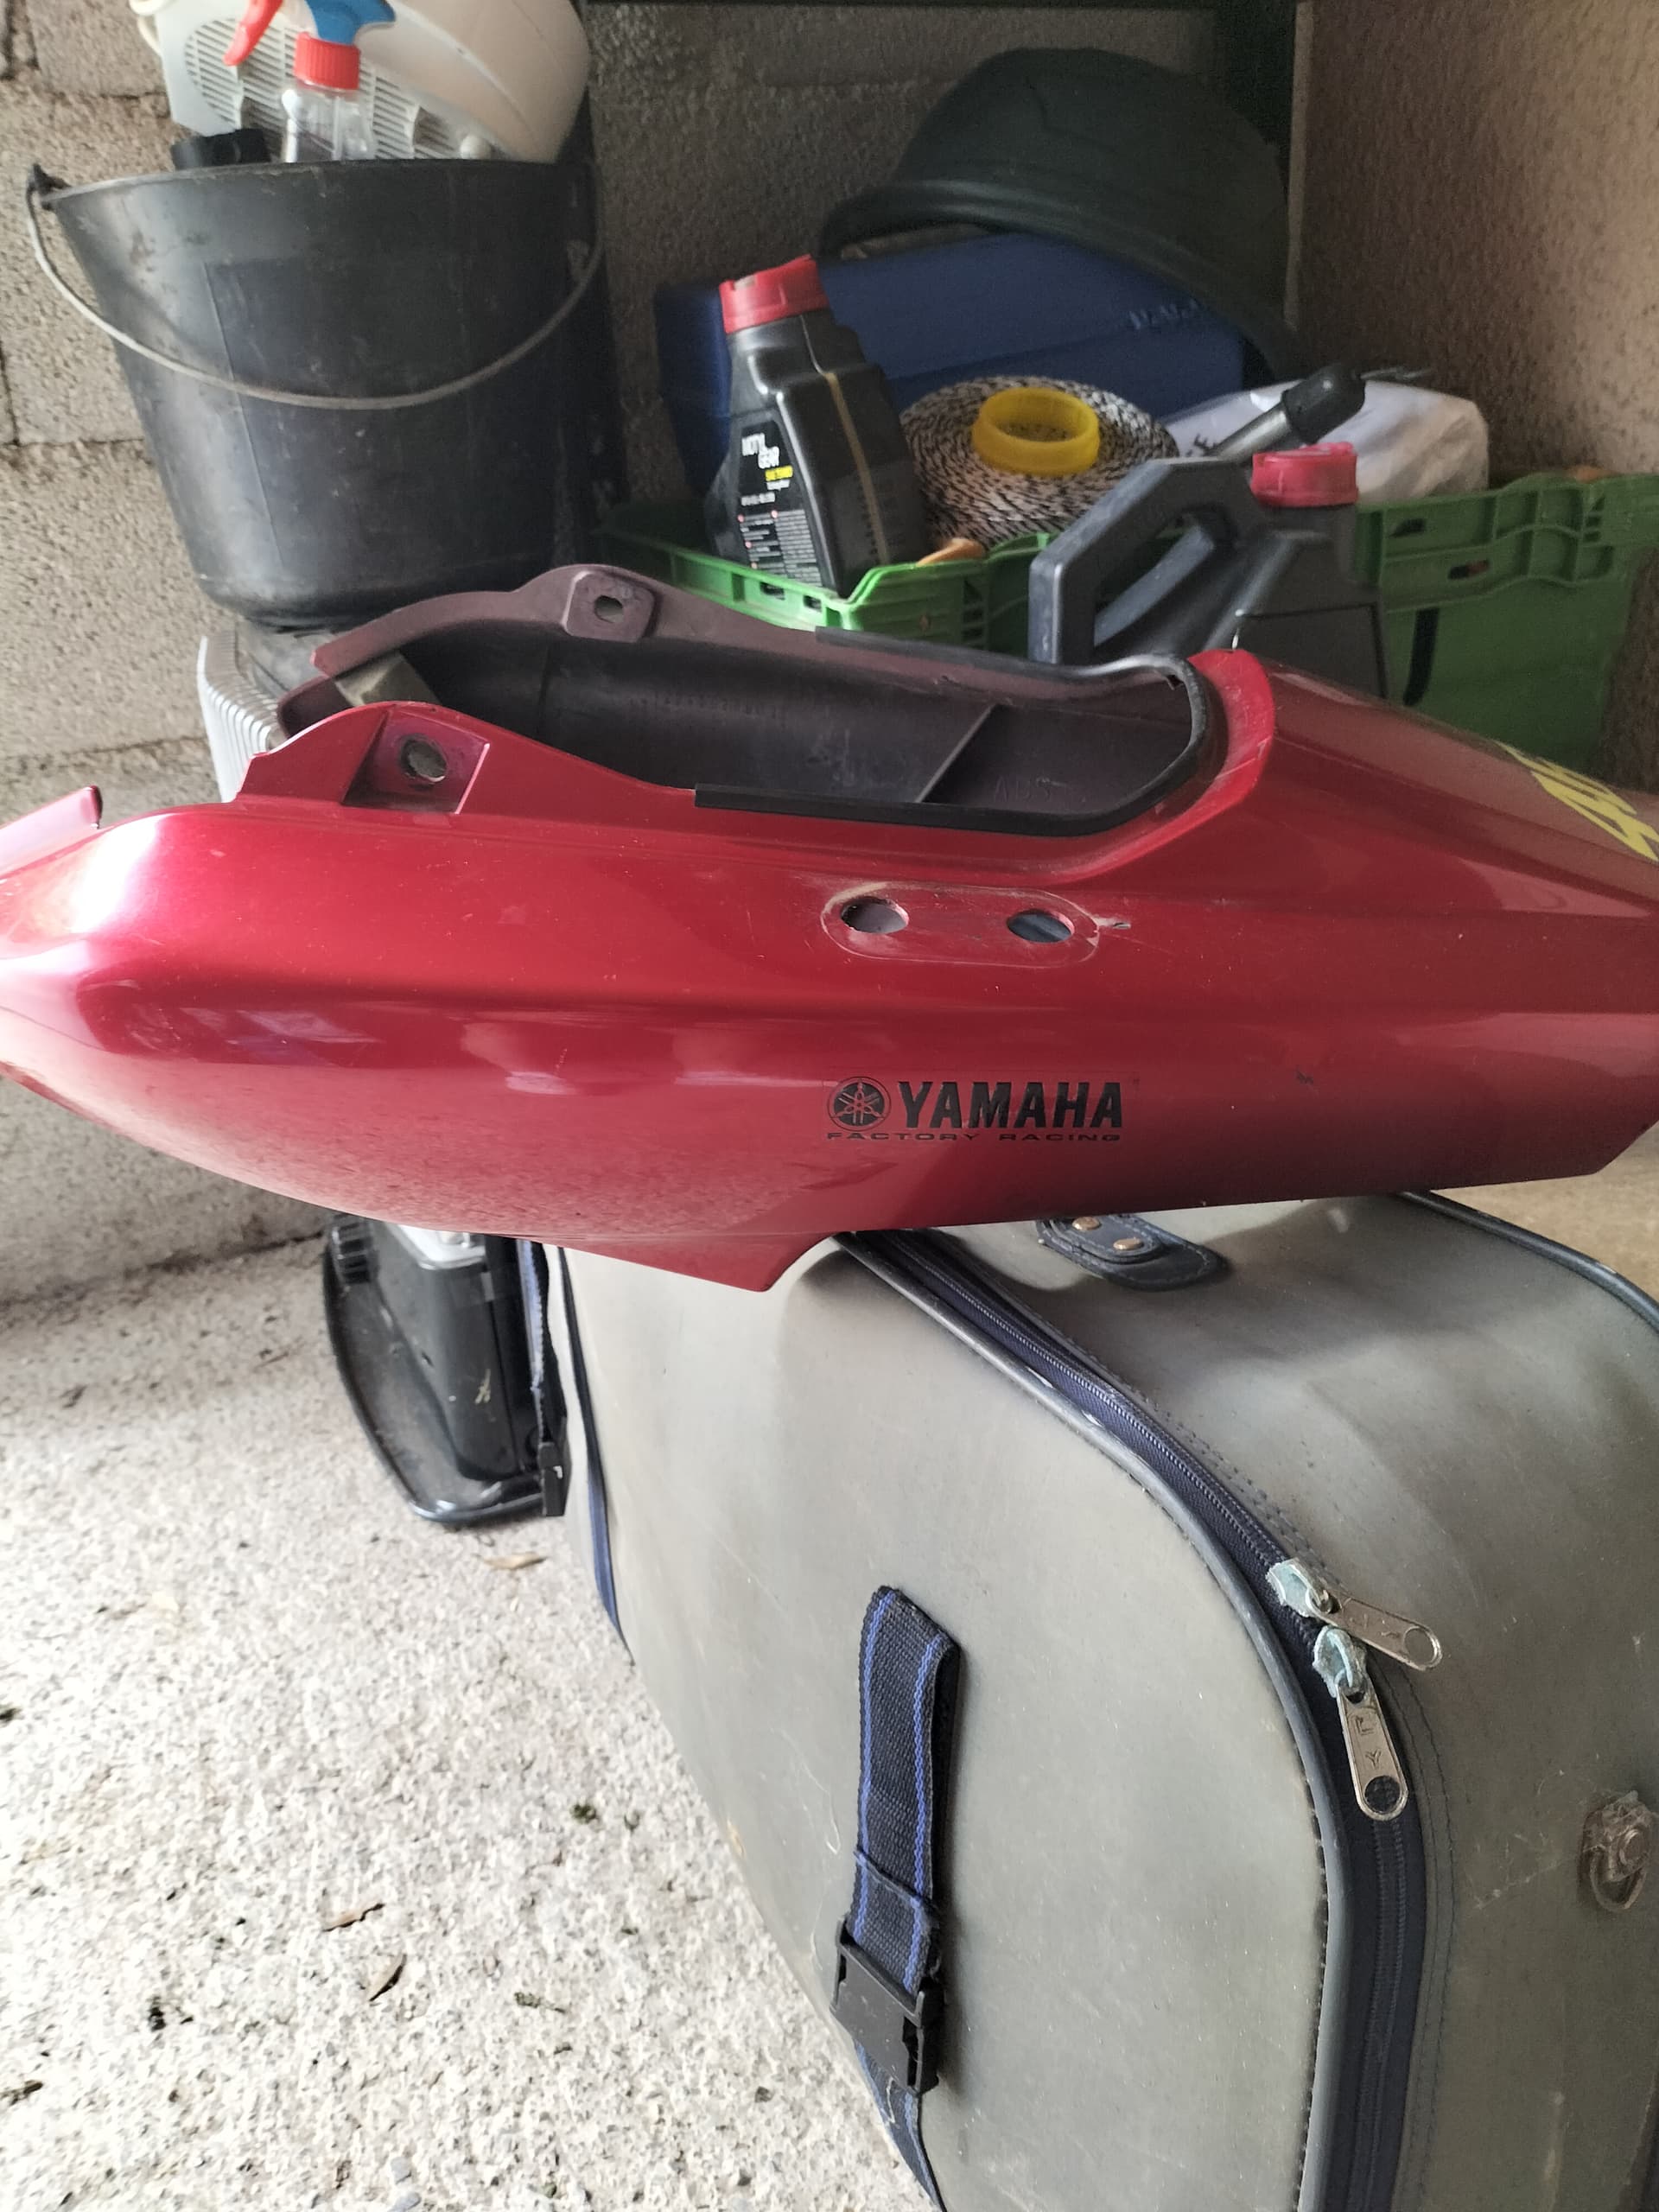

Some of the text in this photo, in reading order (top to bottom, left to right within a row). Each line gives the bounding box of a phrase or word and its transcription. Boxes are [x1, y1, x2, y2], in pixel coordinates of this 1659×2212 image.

[898, 1081, 1122, 1128] YAMAHA
[827, 1132, 1122, 1141] FACTORY RACING
